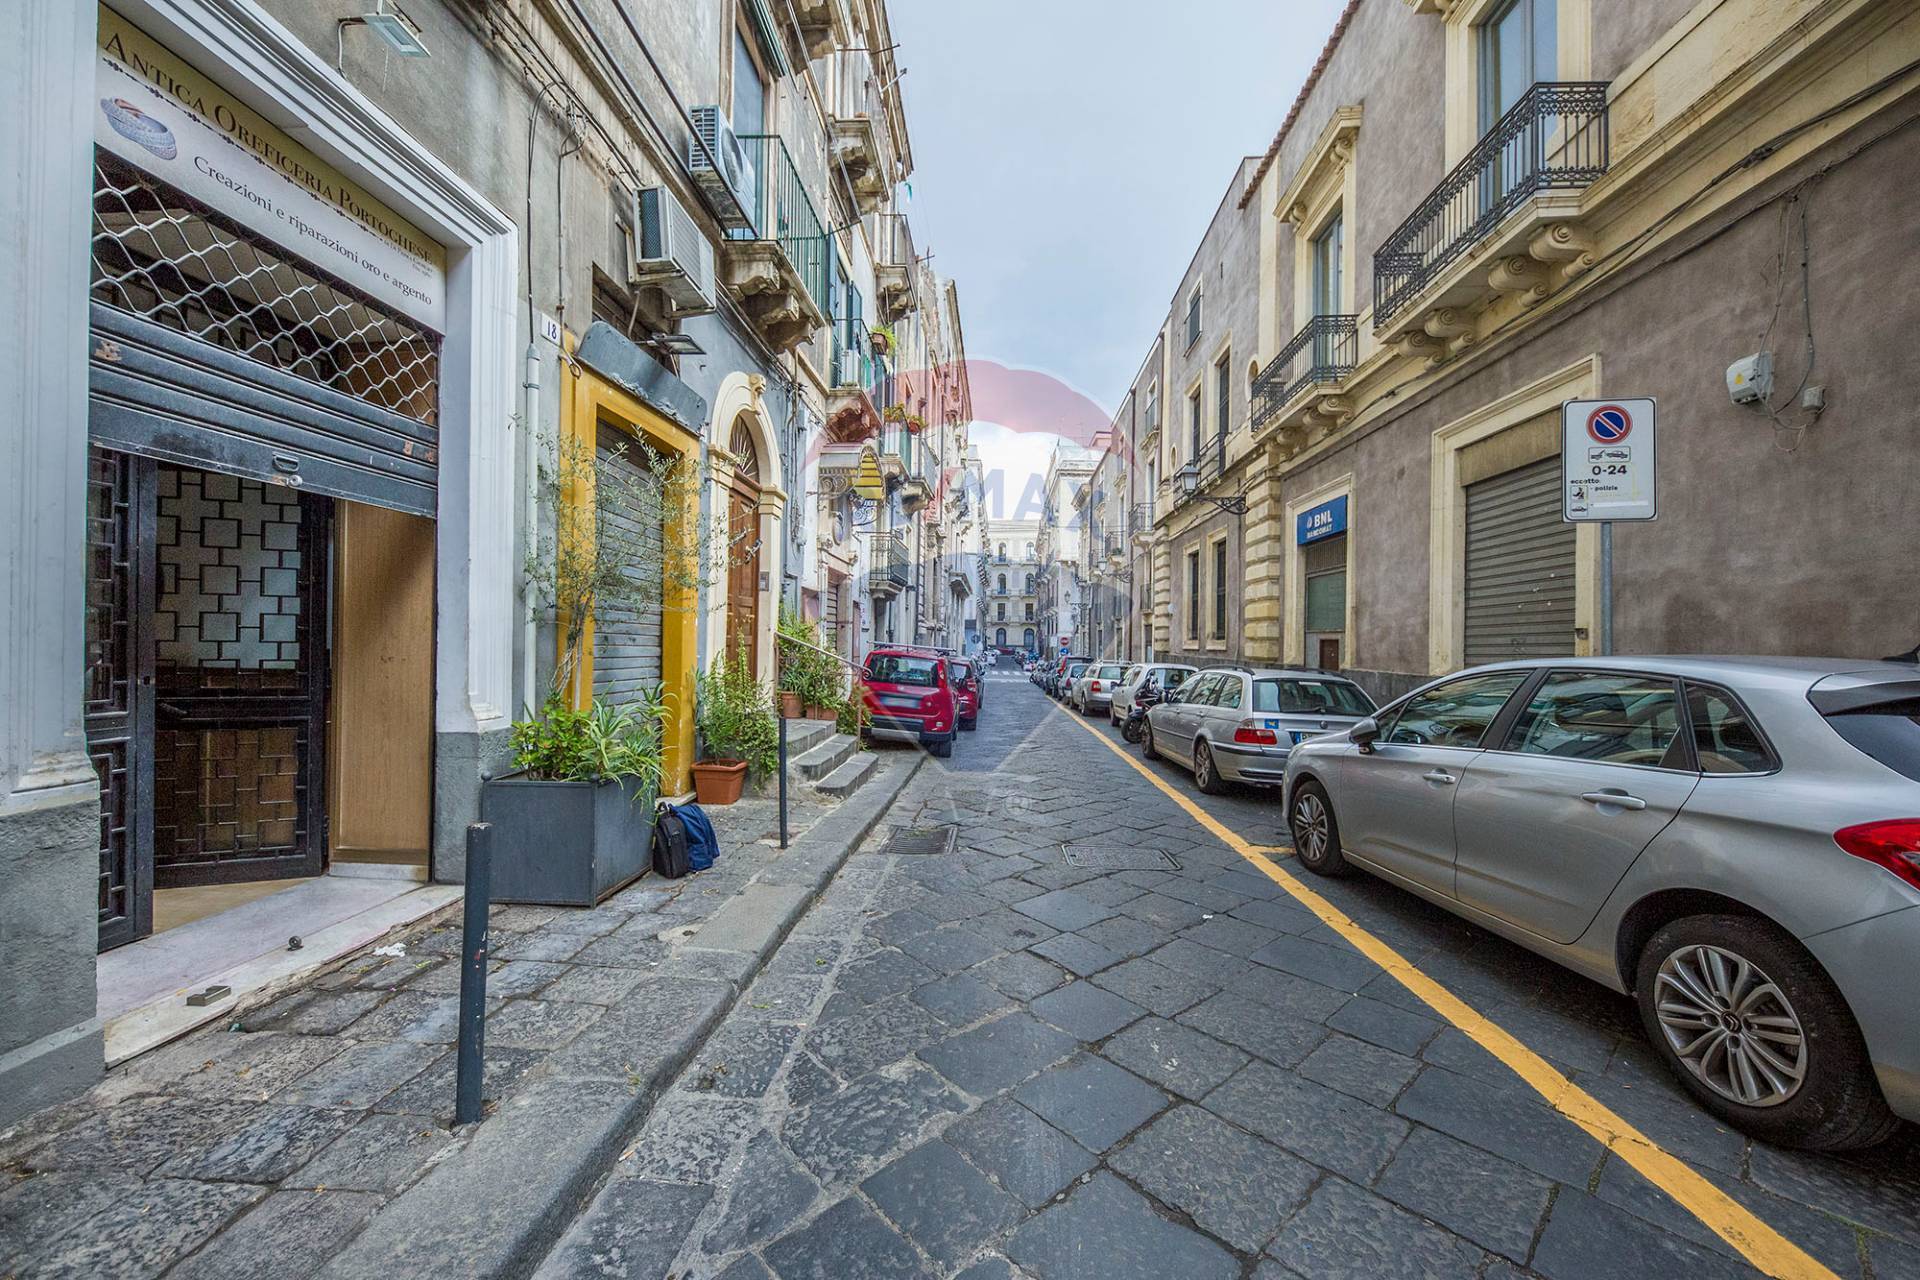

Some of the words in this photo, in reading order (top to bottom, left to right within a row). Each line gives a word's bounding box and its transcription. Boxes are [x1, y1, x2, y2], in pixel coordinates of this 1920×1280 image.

[105, 32, 208, 118] ANTICA
[214, 104, 334, 201] OREFICERIA
[340, 187, 433, 265] PORTOGHESE
[194, 156, 273, 213] Creazioni
[276, 208, 285, 219] e
[289, 215, 358, 263] riparazioni
[361, 259, 381, 276] oro
[383, 272, 390, 281] e
[392, 278, 432, 305] argento
[548, 321, 557, 339] 18
[1592, 465, 1627, 475] 0-24
[1314, 510, 1333, 527] BNL
